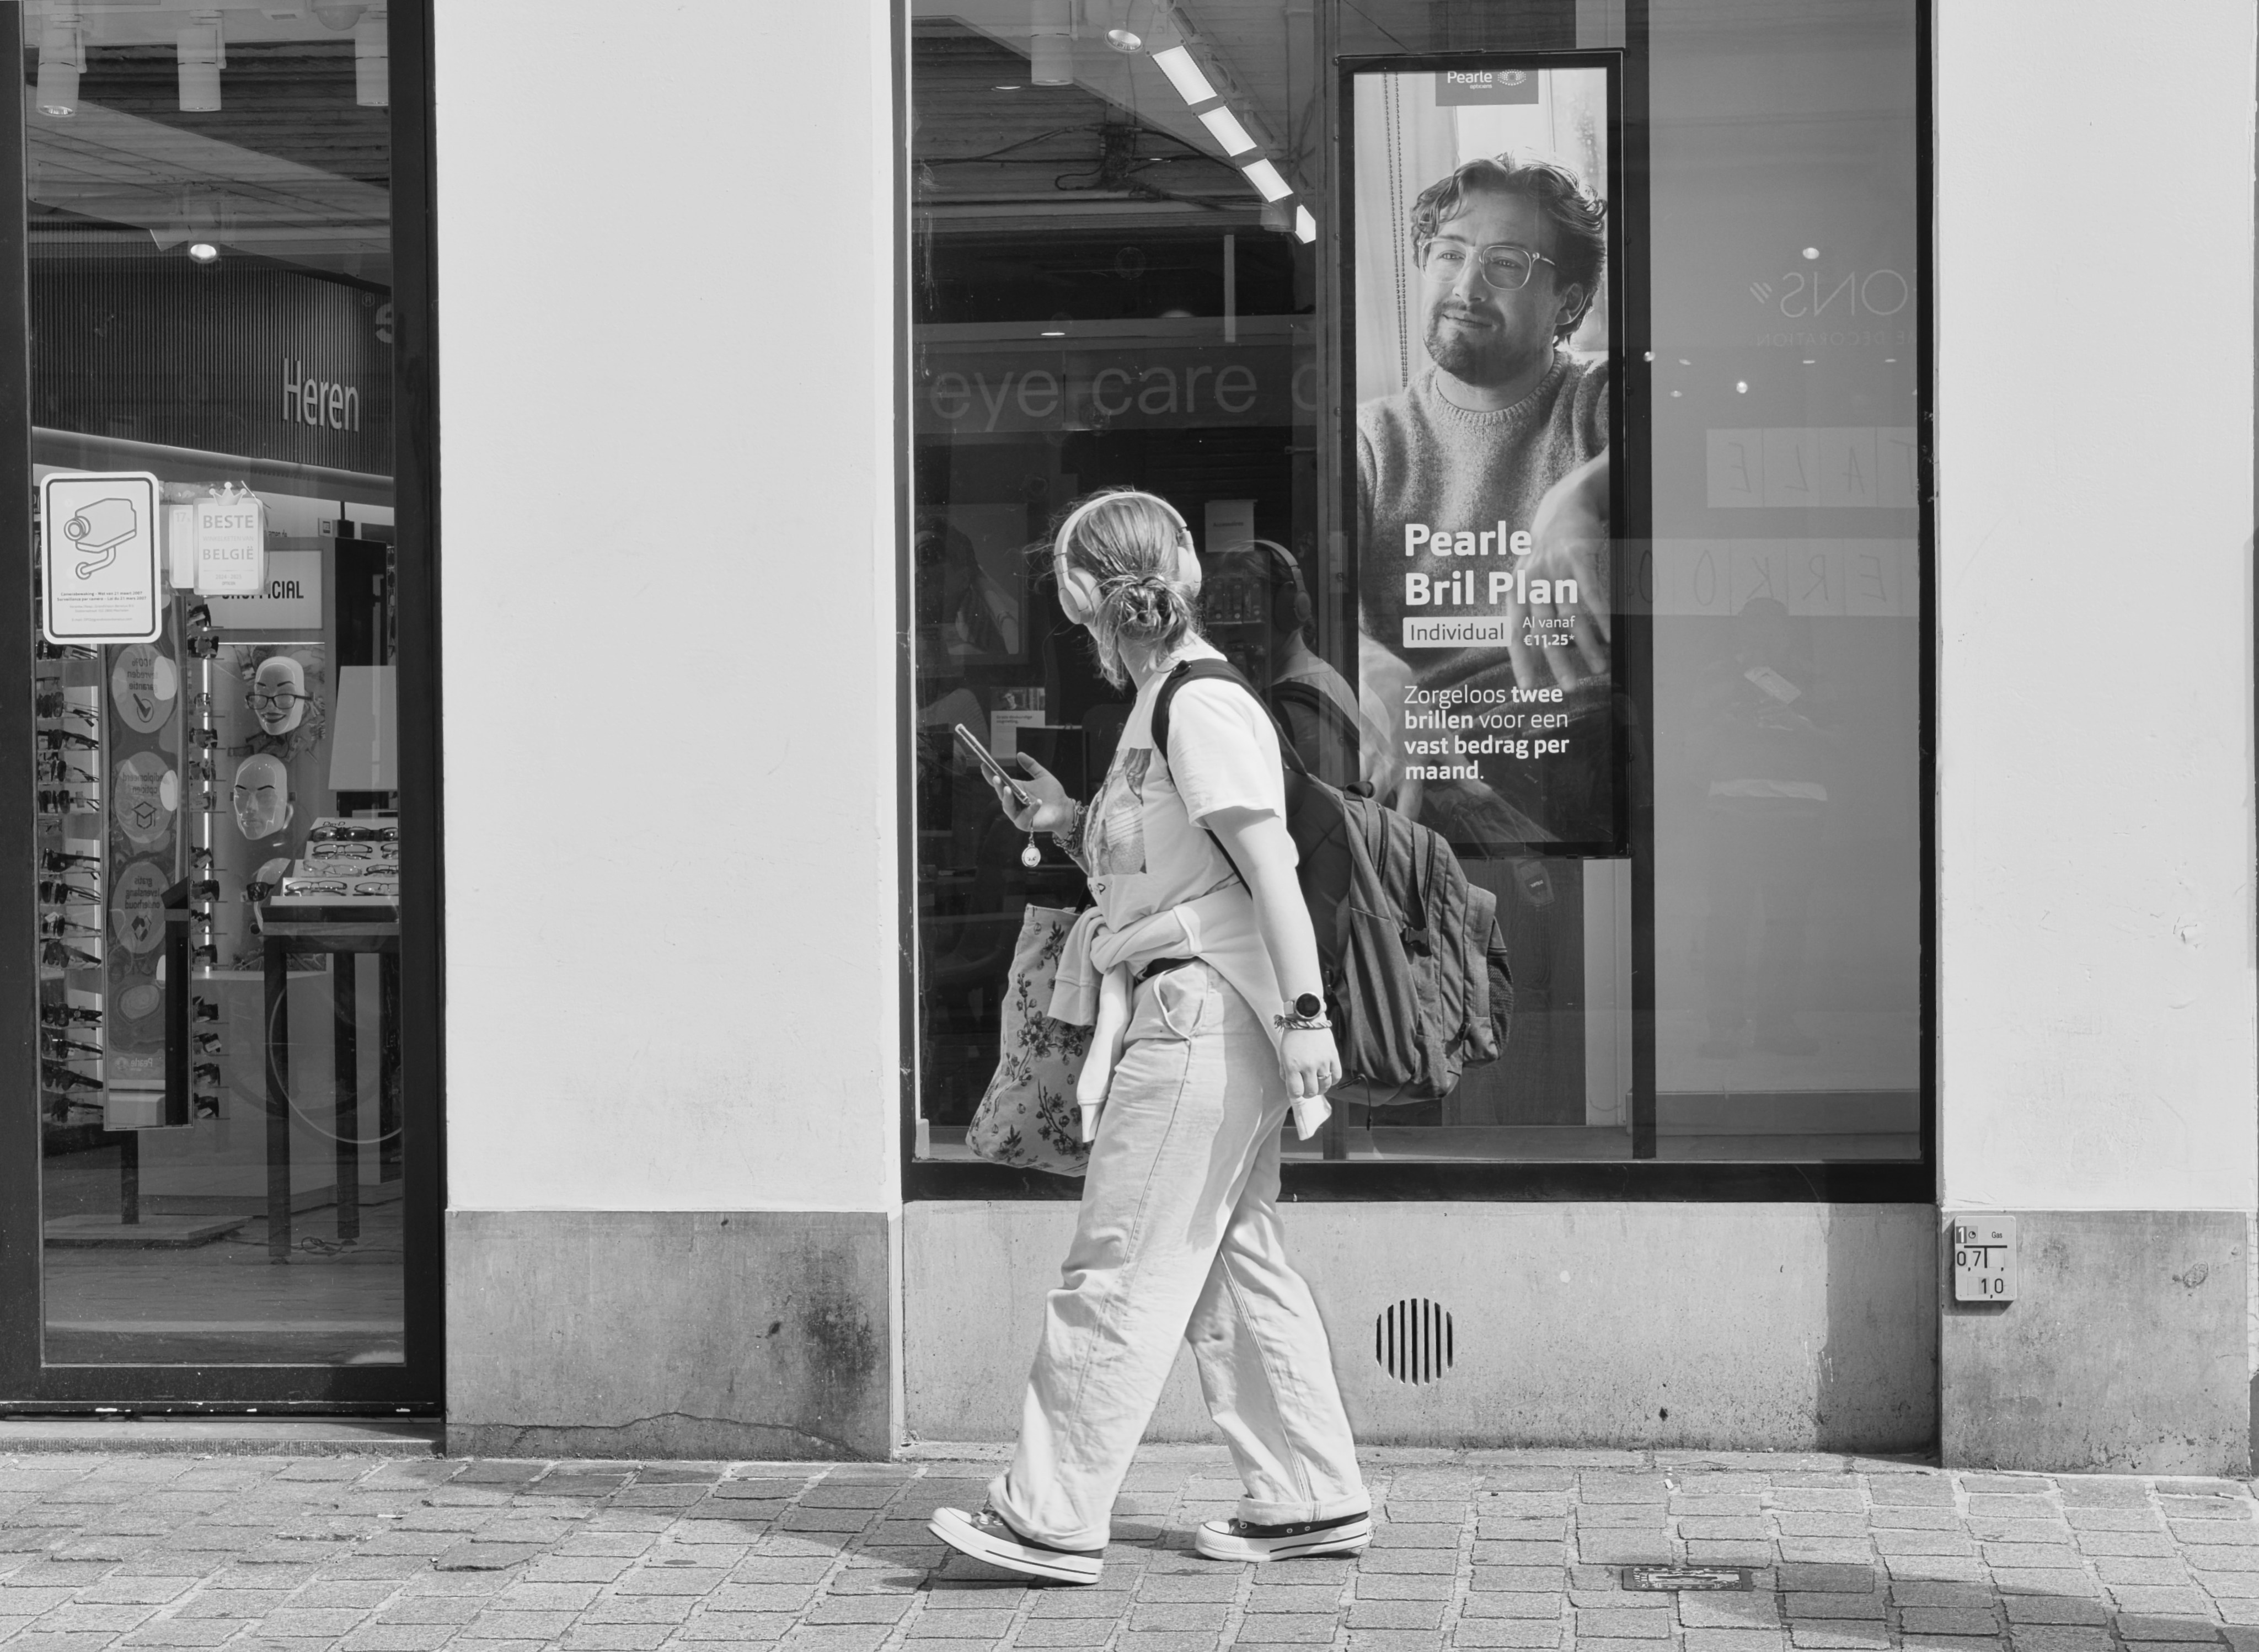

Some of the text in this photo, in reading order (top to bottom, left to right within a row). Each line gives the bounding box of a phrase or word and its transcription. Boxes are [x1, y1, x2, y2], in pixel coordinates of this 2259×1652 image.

[1447, 70, 1492, 83] Pearle
[282, 357, 359, 432] Heren
[929, 369, 1059, 431] eye
[1091, 364, 1258, 415] care
[203, 515, 254, 528] BESTE
[1405, 521, 1532, 557] Pearle
[203, 546, 254, 560] BELGIË
[1406, 570, 1578, 606] Bril Plan
[1523, 616, 1575, 628] Al vanaf
[1410, 623, 1504, 641] Individual
[1404, 685, 1563, 709] Zorgeloos twee
[1405, 710, 1568, 729] brillen voor een
[1404, 735, 1570, 759] vast bedrag per
[1405, 760, 1484, 780] maand.
[1958, 1227, 1965, 1243] 1
